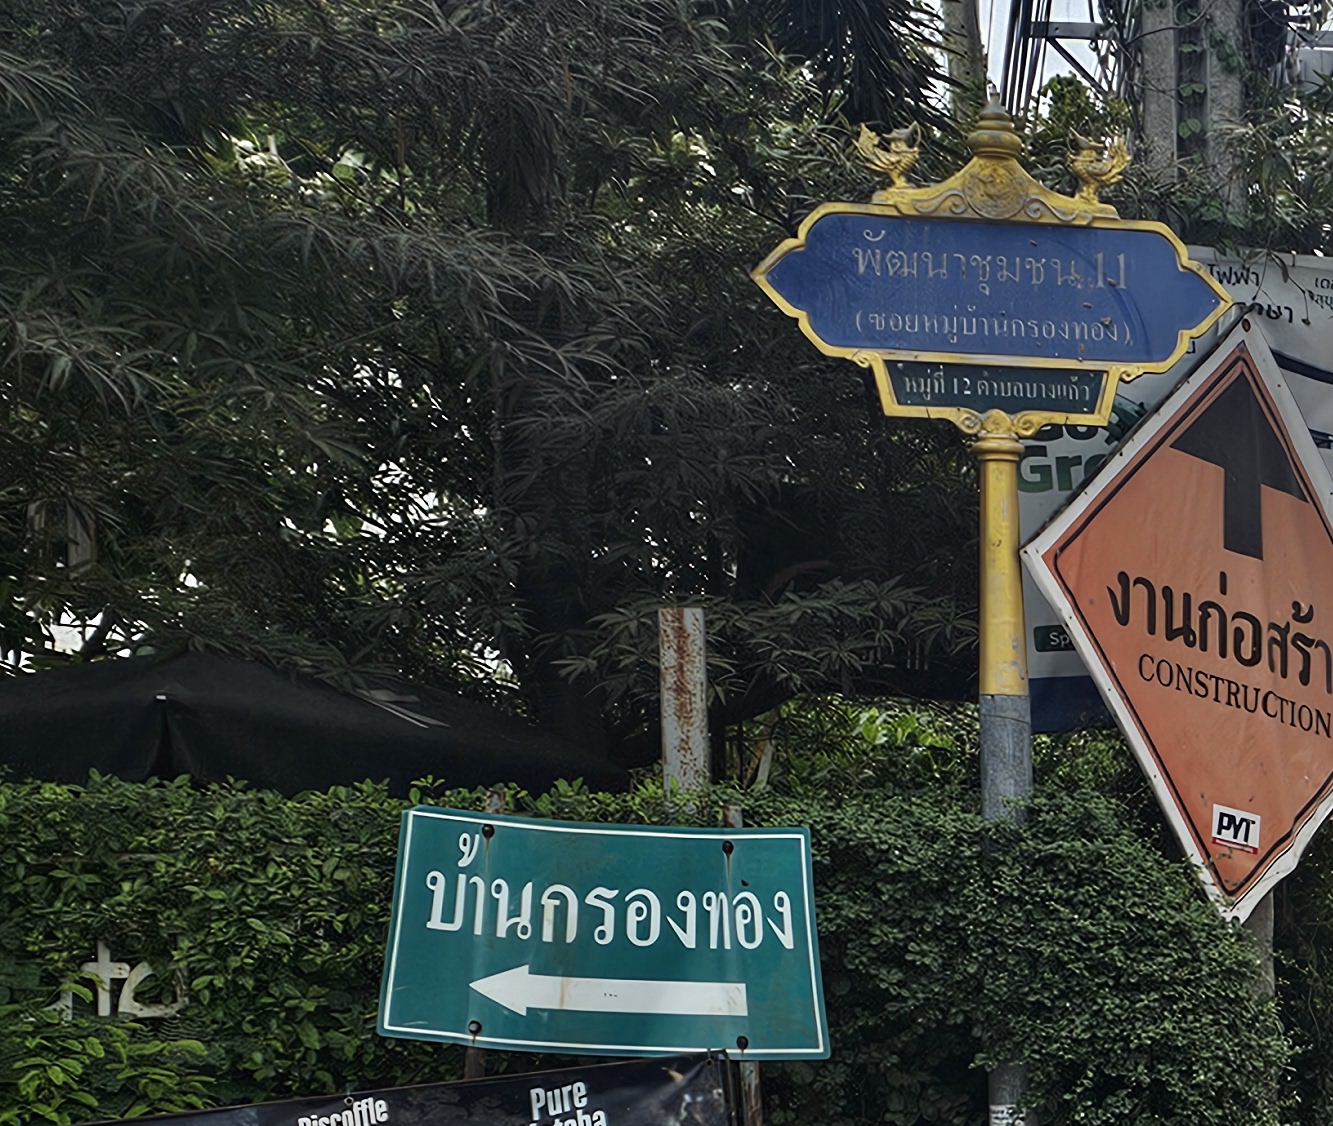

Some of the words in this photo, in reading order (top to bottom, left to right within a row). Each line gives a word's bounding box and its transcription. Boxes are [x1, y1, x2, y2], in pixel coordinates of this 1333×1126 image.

[953, 377, 972, 395] 12
[1138, 653, 1332, 739] CONSTRUCTION
[1216, 811, 1256, 843] PYT
[425, 832, 794, 950] บ้านกรองทอง
[530, 1082, 588, 1121] Pure
